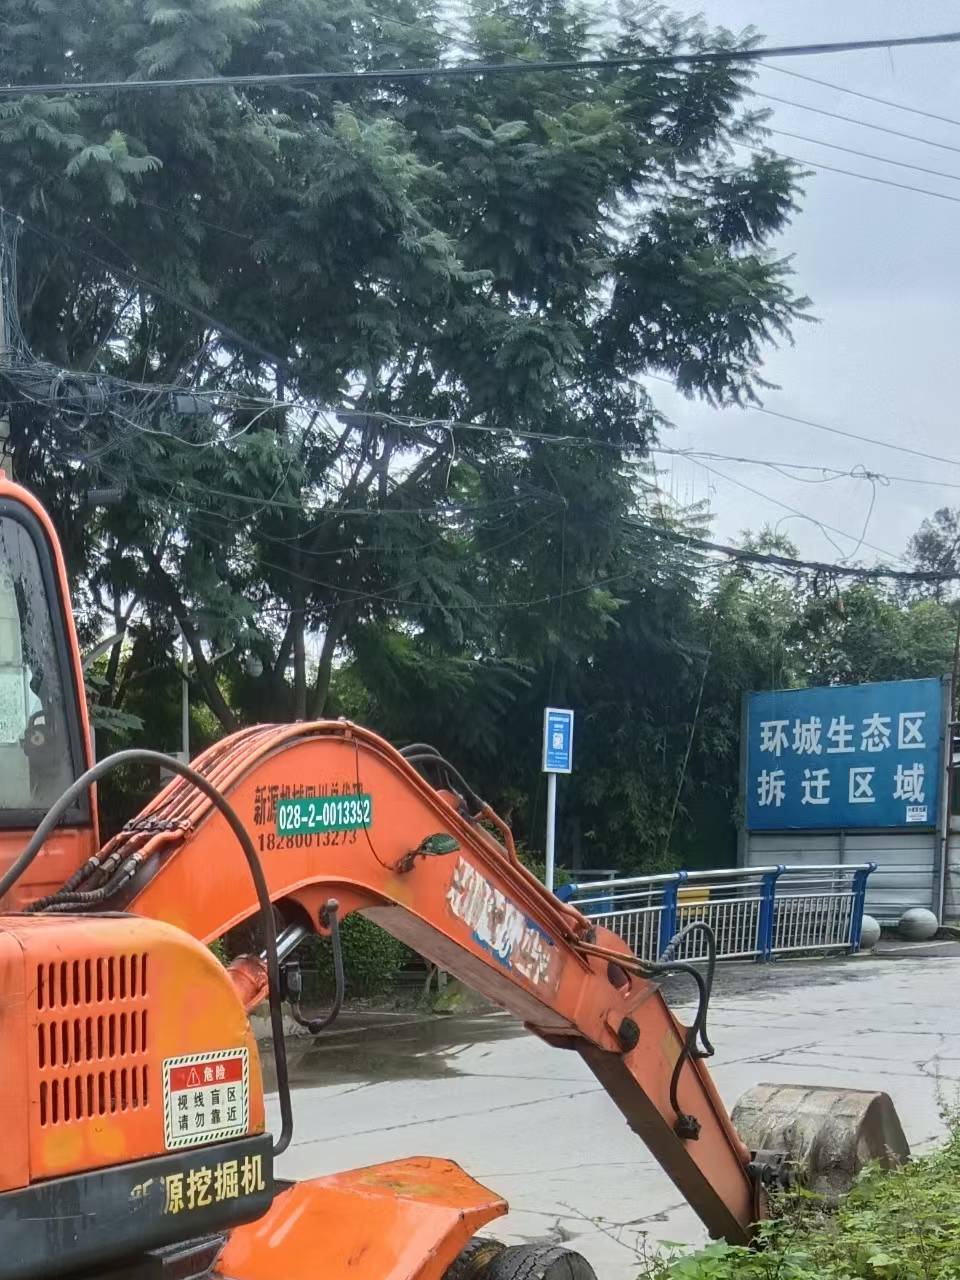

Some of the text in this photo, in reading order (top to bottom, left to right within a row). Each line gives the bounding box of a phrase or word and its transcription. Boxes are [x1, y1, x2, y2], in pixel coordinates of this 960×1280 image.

[759, 711, 926, 756] 环城生态区
[757, 762, 925, 807] 拆迁区域
[203, 1064, 226, 1083] 危险
[177, 1086, 237, 1112] 视线盲区
[178, 1106, 238, 1131] 请勿靠近
